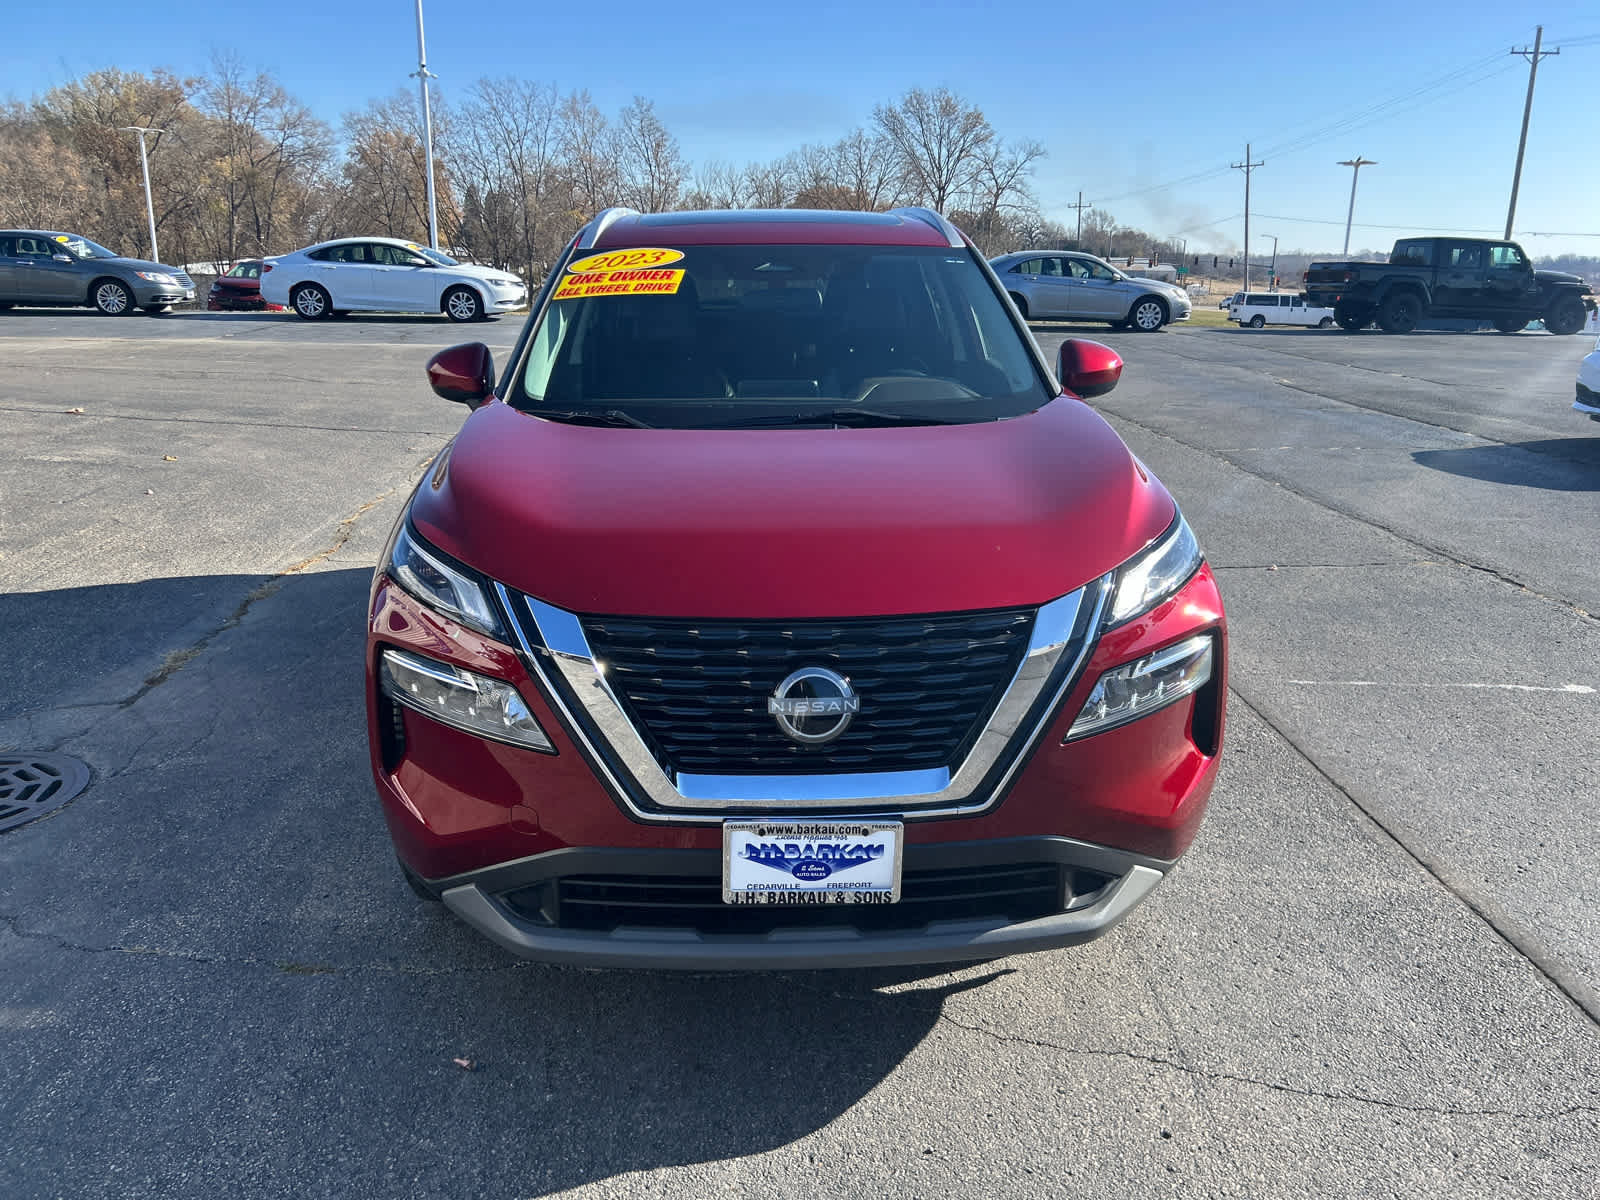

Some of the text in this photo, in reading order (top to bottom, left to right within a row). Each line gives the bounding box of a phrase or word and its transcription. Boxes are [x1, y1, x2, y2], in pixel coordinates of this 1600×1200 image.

[586, 251, 666, 270] 2023
[567, 270, 675, 285] ONE OWNER
[556, 283, 675, 297] ALL WHEEL DRIVE
[771, 700, 857, 712] NISSAN
[765, 823, 861, 836] www.barkau.com
[826, 881, 873, 889] FREEPORT
[767, 890, 827, 904] BARKAU
[834, 890, 846, 904] &
[853, 890, 892, 904] SONS
